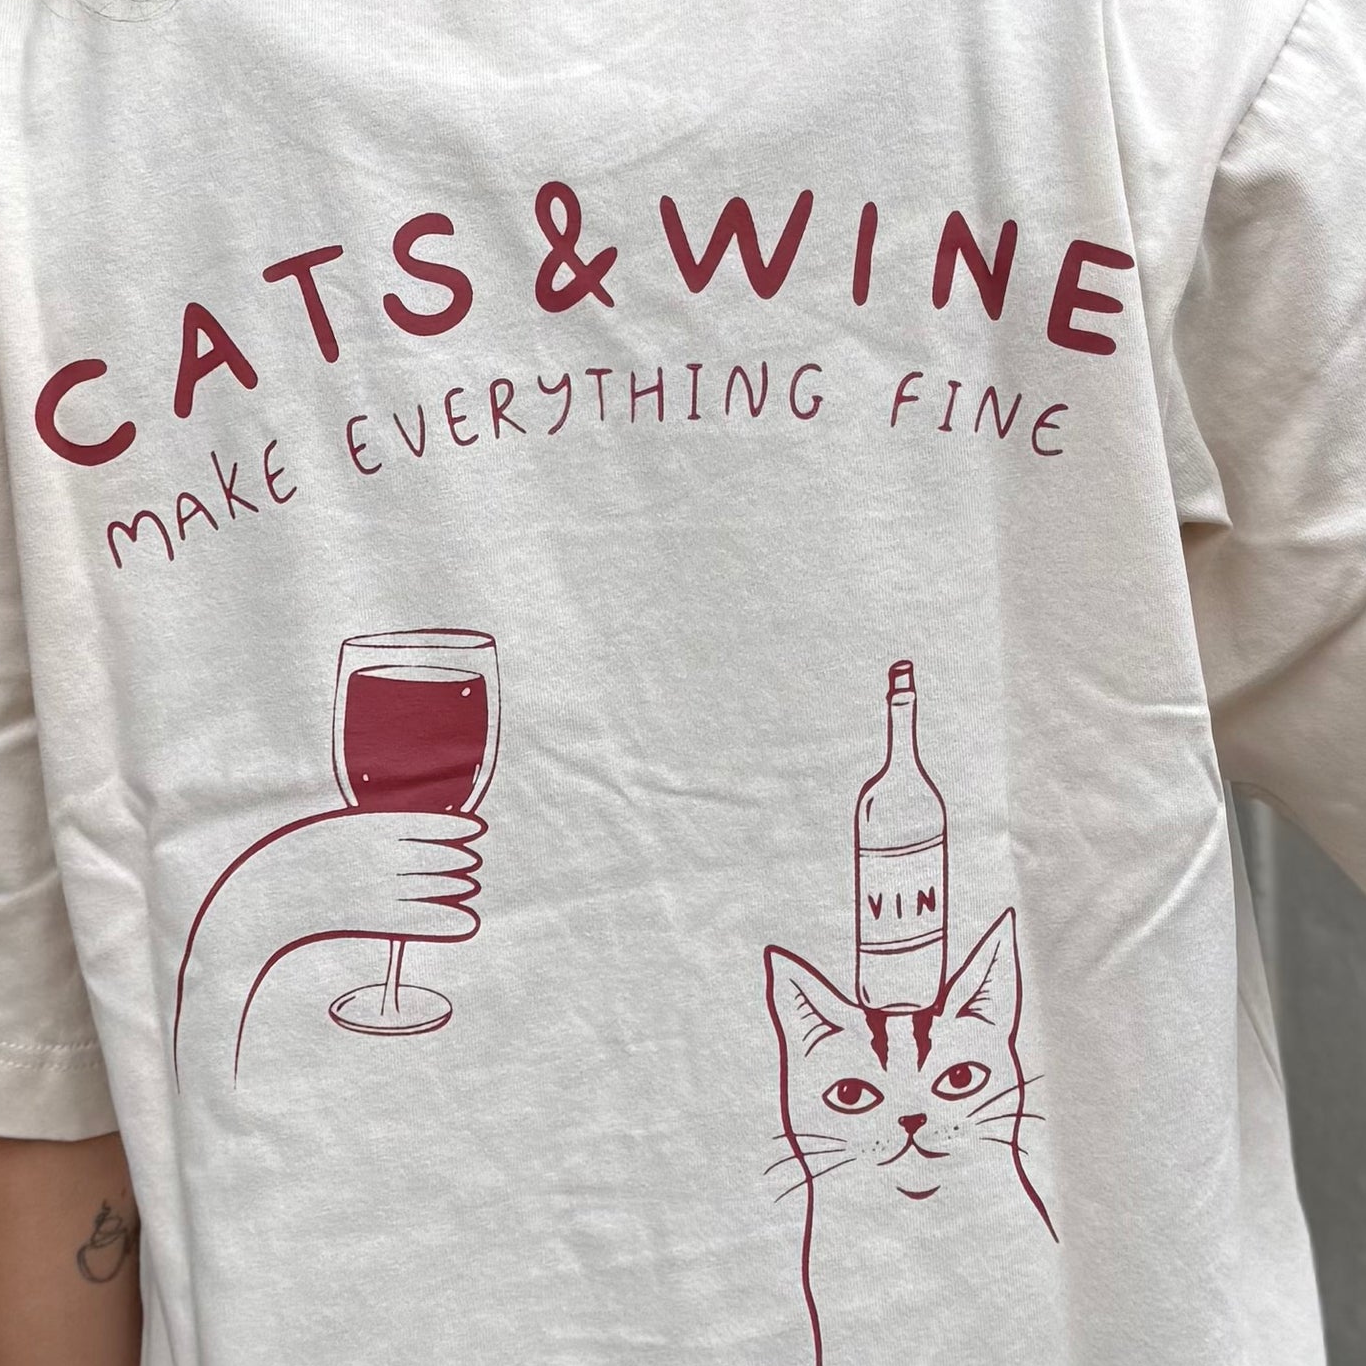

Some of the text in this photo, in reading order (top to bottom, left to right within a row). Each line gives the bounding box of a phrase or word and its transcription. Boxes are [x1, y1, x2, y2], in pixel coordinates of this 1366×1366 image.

[105, 361, 1070, 569] MAKE EVERYTHING FINE
[867, 885, 937, 921] VIN
